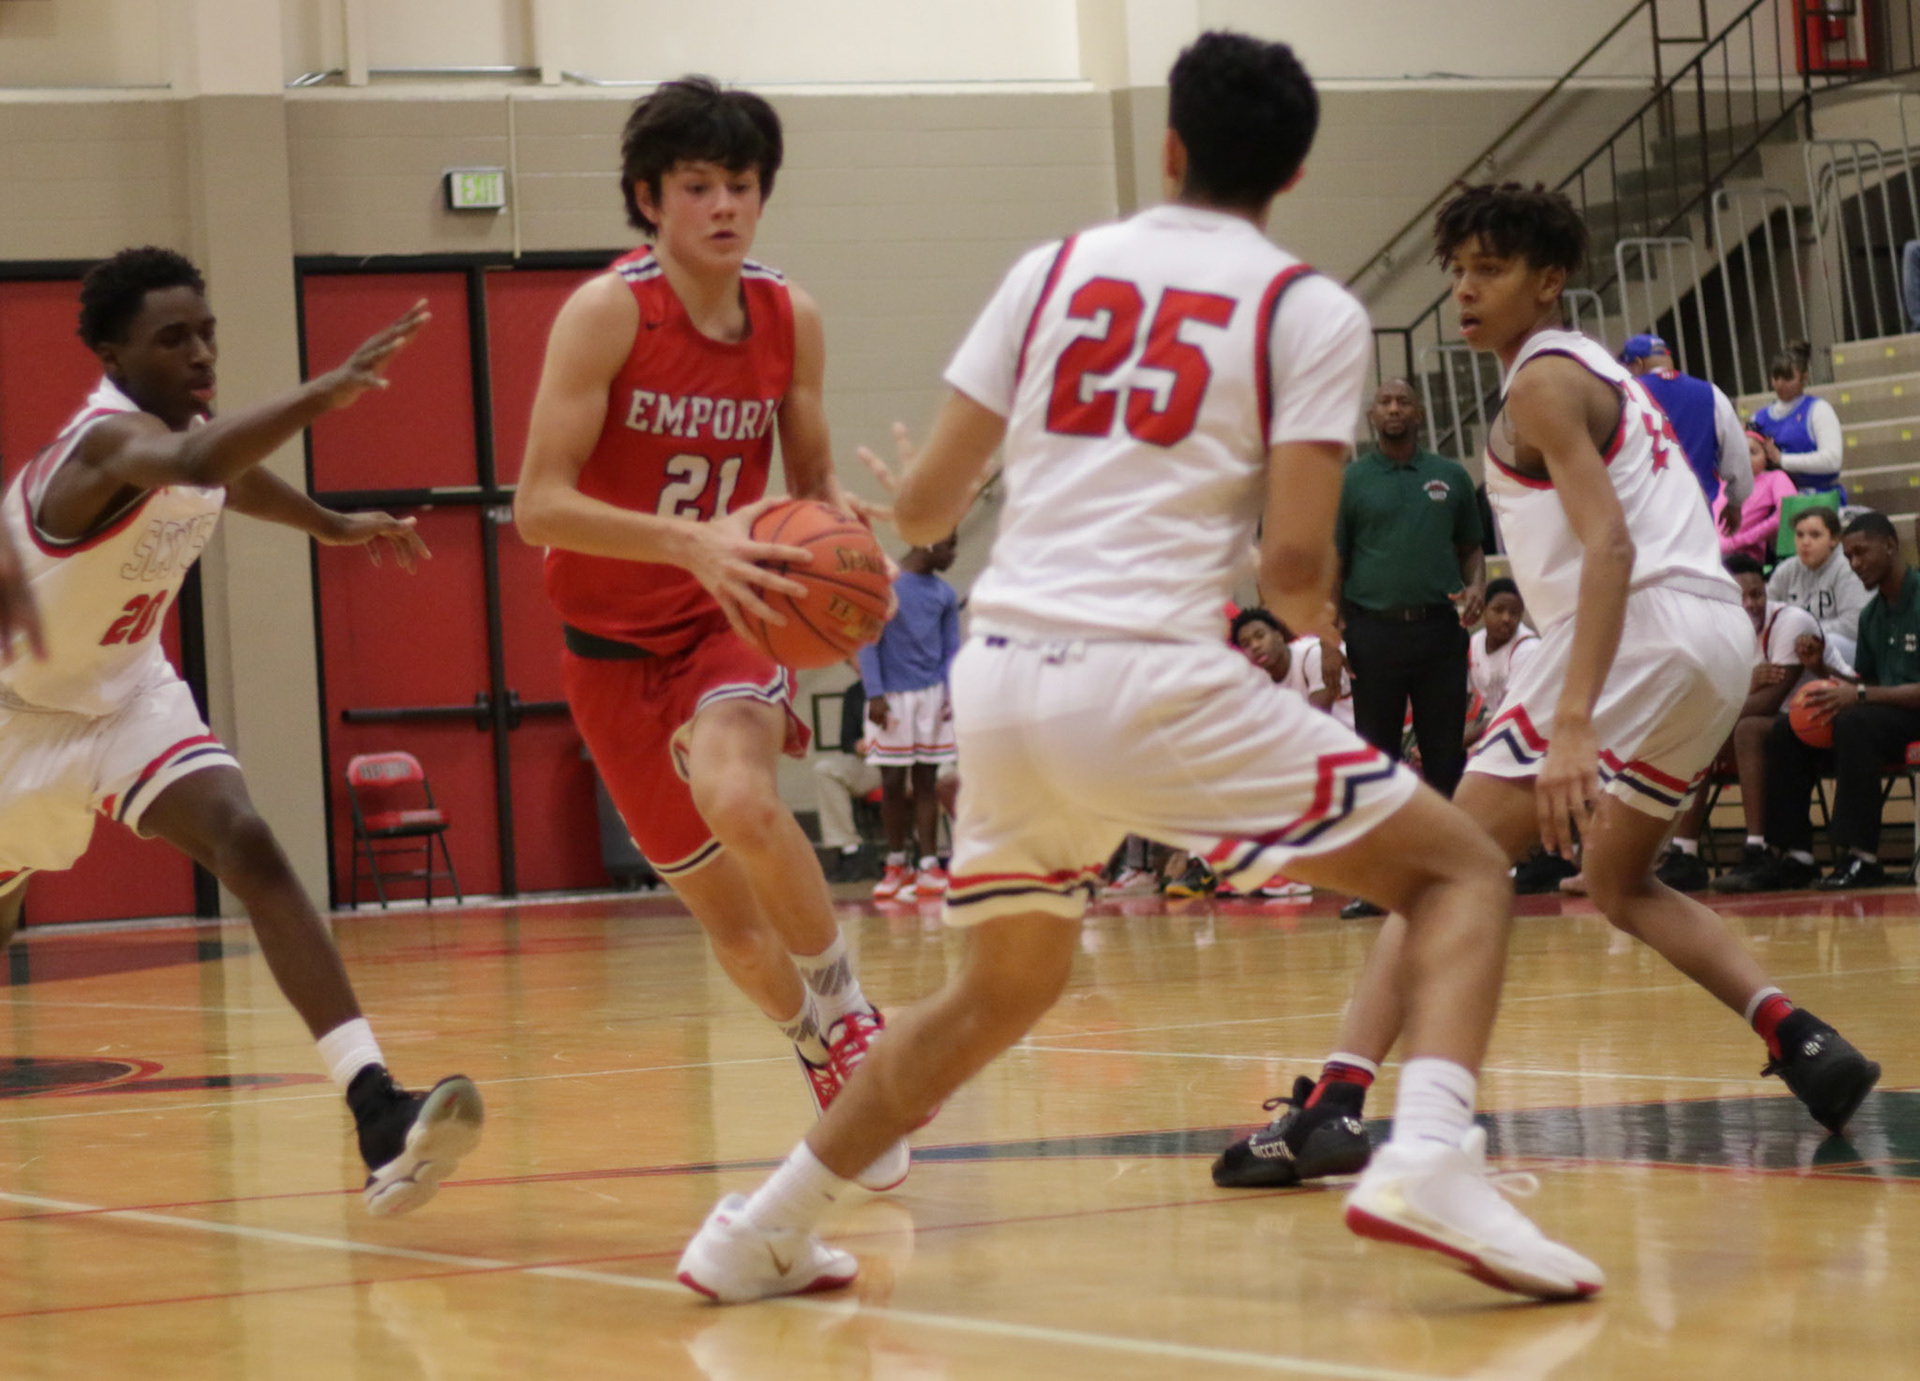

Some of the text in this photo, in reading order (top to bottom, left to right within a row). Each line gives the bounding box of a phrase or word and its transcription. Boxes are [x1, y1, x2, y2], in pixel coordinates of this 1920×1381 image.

[461, 173, 497, 204] EXIT
[1045, 276, 1240, 448] 25
[656, 454, 742, 522] 21
[99, 589, 168, 646] 20
